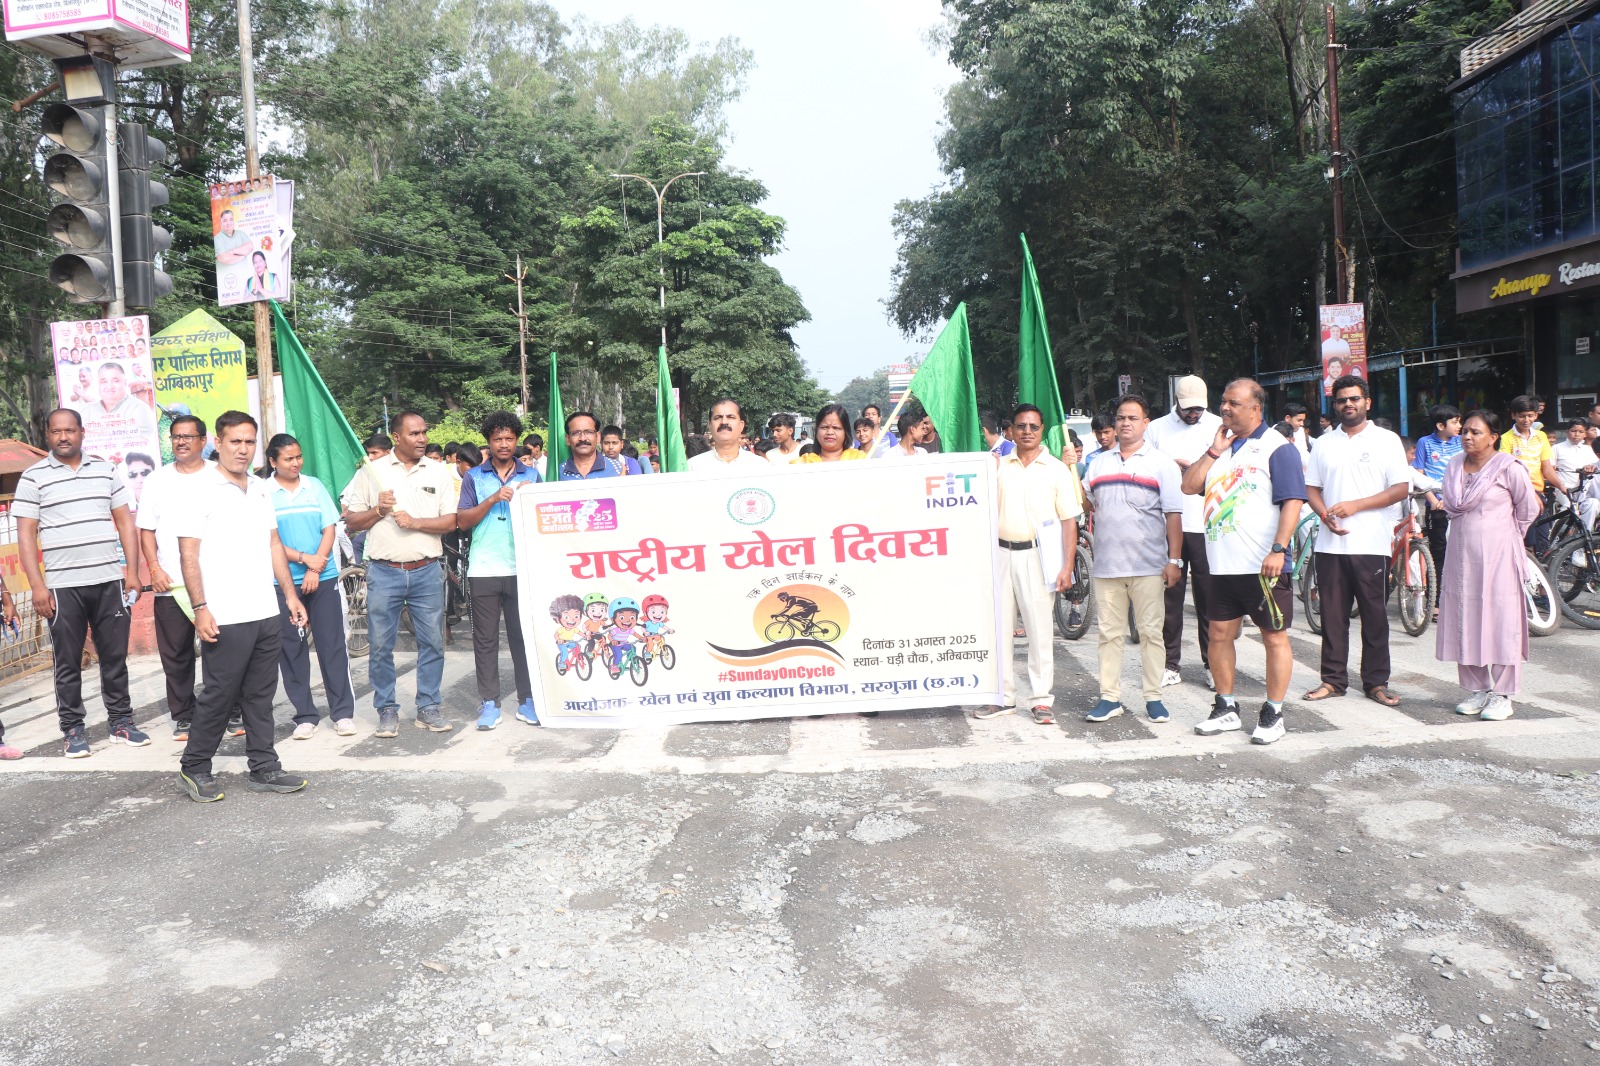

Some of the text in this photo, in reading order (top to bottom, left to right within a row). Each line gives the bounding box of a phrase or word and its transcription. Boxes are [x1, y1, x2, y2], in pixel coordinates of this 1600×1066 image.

[44, 9, 81, 20] 8085758585
[1490, 273, 1551, 299] Ananya
[185, 329, 231, 344] सर्वेक्षण
[168, 350, 208, 371] पालिक
[210, 347, 242, 368] निगम
[154, 373, 214, 393] अम्बिकापुर
[926, 495, 978, 509] INDIA
[540, 509, 613, 524] रजत 25
[566, 523, 949, 583] राष्ट्रीय खेल दिवस
[746, 587, 761, 599] एक
[761, 576, 781, 589] दिन
[840, 584, 856, 598] नाम
[862, 634, 977, 651] दिनांक 31 अगस्त 2025
[853, 656, 884, 667] स्थान-
[886, 653, 904, 666] घड़ी
[936, 649, 989, 663] अम्बिकापुर
[718, 665, 836, 683] #SundayOnCycle
[638, 692, 671, 706] खेल
[676, 689, 697, 704] एवं
[702, 690, 731, 705] युवा
[736, 686, 794, 700] कल्याण
[860, 679, 918, 695] सरगुजा
[923, 674, 979, 691] (छ.ग.)
